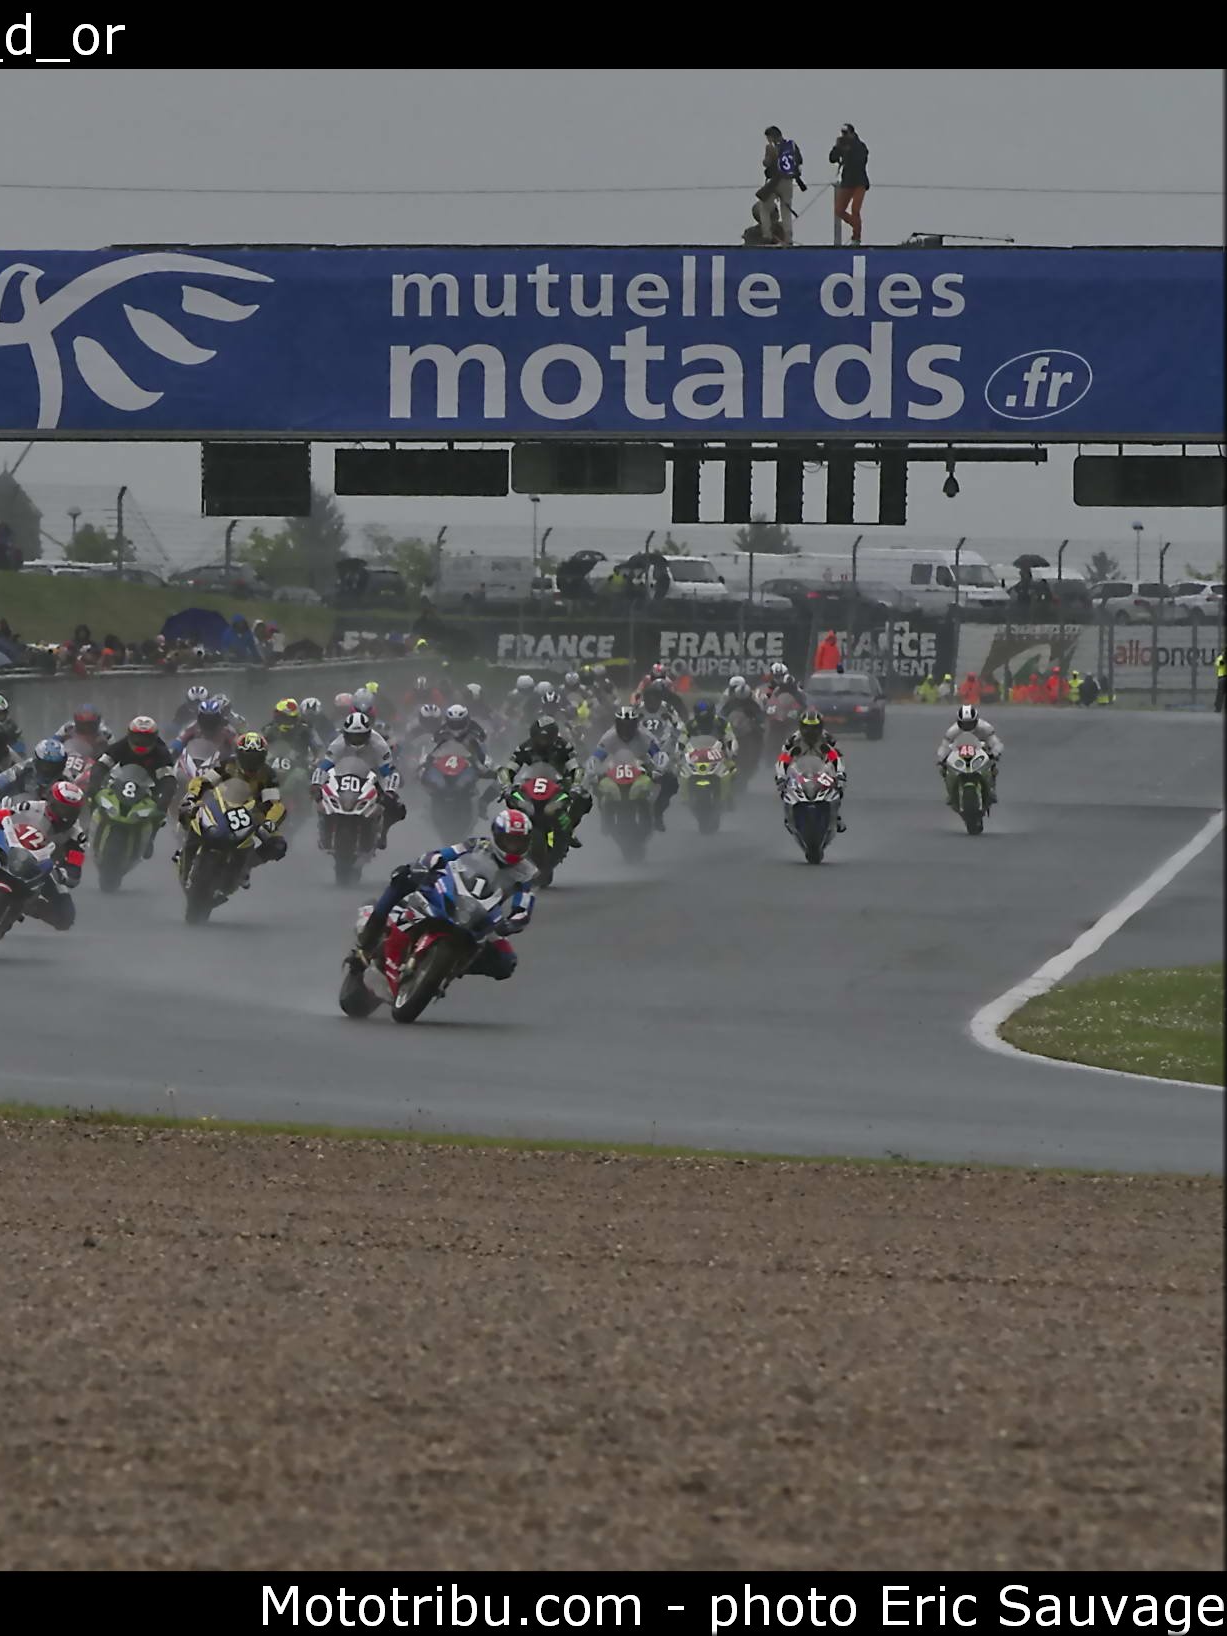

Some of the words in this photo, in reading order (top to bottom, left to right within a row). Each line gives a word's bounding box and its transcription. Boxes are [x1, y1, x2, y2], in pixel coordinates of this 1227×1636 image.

[391, 255, 781, 318] mutuelle
[820, 255, 966, 318] des
[389, 321, 965, 421] motards
[1004, 356, 1073, 408] .fr
[497, 634, 614, 658] FRANCE
[660, 631, 784, 657] FRANCE
[1114, 639, 1221, 667] allopneu
[445, 756, 458, 768] 4
[122, 781, 136, 798] 8
[533, 778, 548, 793] 5
[227, 807, 251, 831] 55
[471, 876, 486, 897] 1
